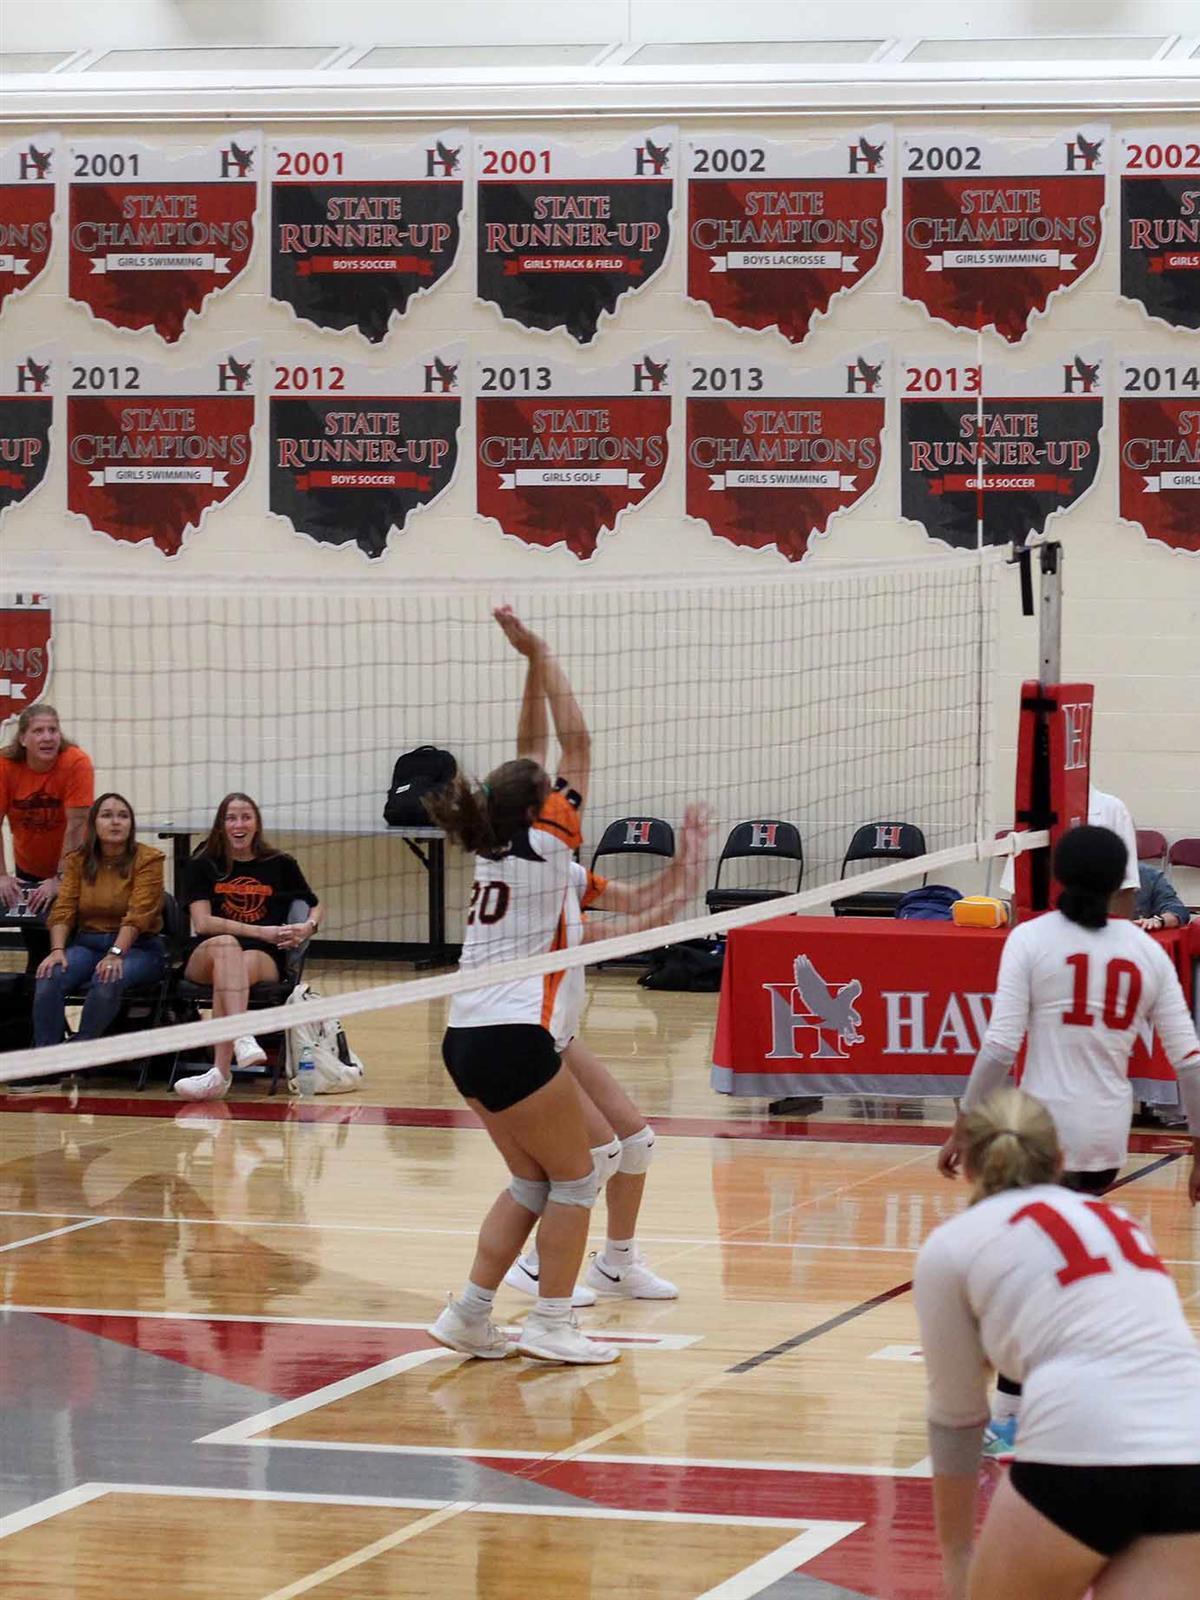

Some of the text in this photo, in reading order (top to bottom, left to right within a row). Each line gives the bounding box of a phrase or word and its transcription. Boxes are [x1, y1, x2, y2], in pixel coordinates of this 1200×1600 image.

[73, 154, 140, 177] 2001
[276, 152, 344, 175] 2001
[482, 150, 551, 174] 2001
[693, 148, 766, 172] 2002
[908, 147, 982, 171] 2002
[1126, 144, 1200, 169] 2002
[122, 196, 197, 219] STATE
[326, 198, 401, 220] STATE
[533, 197, 609, 219] STATE
[744, 192, 823, 215] STATE
[961, 190, 1040, 213] STATE
[72, 221, 248, 251] CHAMPIONS
[279, 224, 451, 253] RUNNER-UP
[486, 223, 660, 252] RUNNER-UP
[690, 218, 877, 249] CHAMPIONS
[905, 215, 1096, 247] CHAMPIONS
[118, 257, 203, 268] GIRLS SWIMMING
[332, 260, 396, 270] BOYS SOCCER
[524, 259, 622, 269] GIRLS TRACK & FIELD
[742, 255, 826, 265] BOYS LACROSSE
[956, 254, 1047, 264] GIRLS SWIMMING
[1170, 256, 1199, 266] GIRLS
[72, 366, 140, 390] 2012
[274, 367, 344, 390] 2012
[481, 367, 551, 390] 2013
[692, 367, 763, 391] 2013
[905, 367, 981, 391] 2013
[1123, 367, 1199, 391] 2014
[120, 409, 195, 432] STATE
[324, 413, 399, 435] STATE
[533, 409, 609, 432] STATE
[742, 412, 822, 435] STATE
[959, 414, 1038, 437] STATE
[71, 435, 247, 465] CHAMPIONS
[277, 438, 449, 467] RUNNER-UP
[479, 436, 663, 467] CHAMPIONS
[689, 437, 876, 469] CHAMPIONS
[910, 441, 1090, 471] RUNNER-UP
[116, 470, 201, 480] GIRLS SWIMMING
[330, 475, 396, 485] BOYS SOCCER
[542, 472, 601, 482] GIRLS GOLF
[738, 474, 828, 484] GIRLS SWIMMING
[965, 478, 1035, 488] GILS SOCCER
[1063, 953, 1142, 1031] 10
